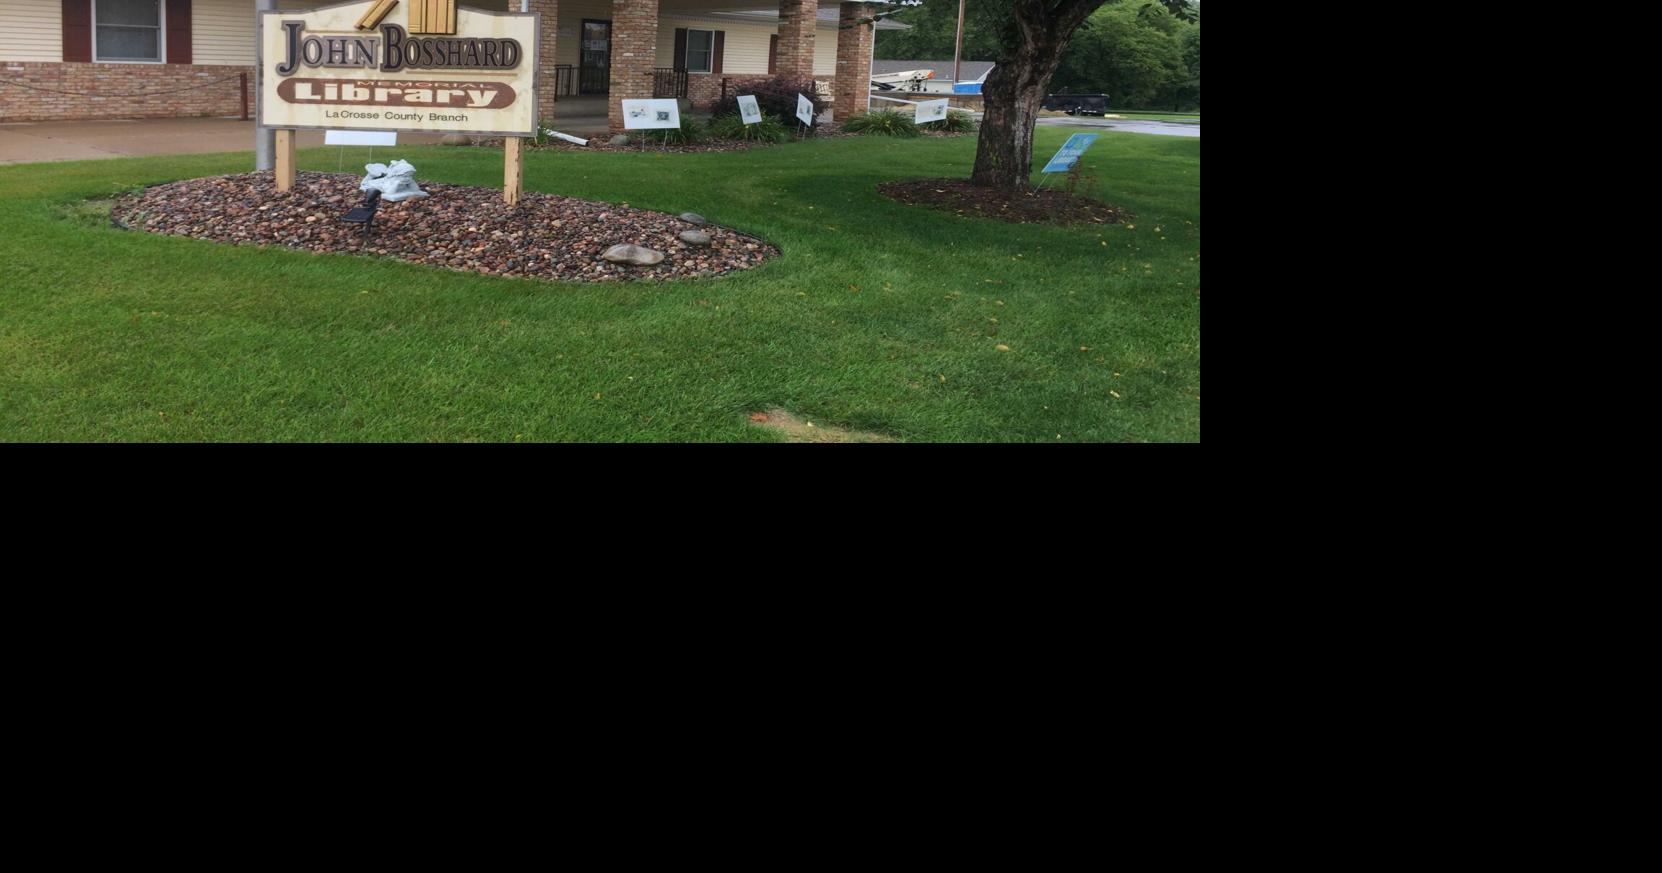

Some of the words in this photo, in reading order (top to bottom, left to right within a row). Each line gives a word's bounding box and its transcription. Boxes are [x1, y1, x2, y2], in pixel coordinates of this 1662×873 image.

[277, 21, 379, 75] JOHN
[381, 23, 522, 72] BOSSHARD
[357, 81, 493, 89] MEMORIAL
[295, 82, 498, 107] Library
[384, 111, 424, 122] County
[429, 113, 469, 122] Branch
